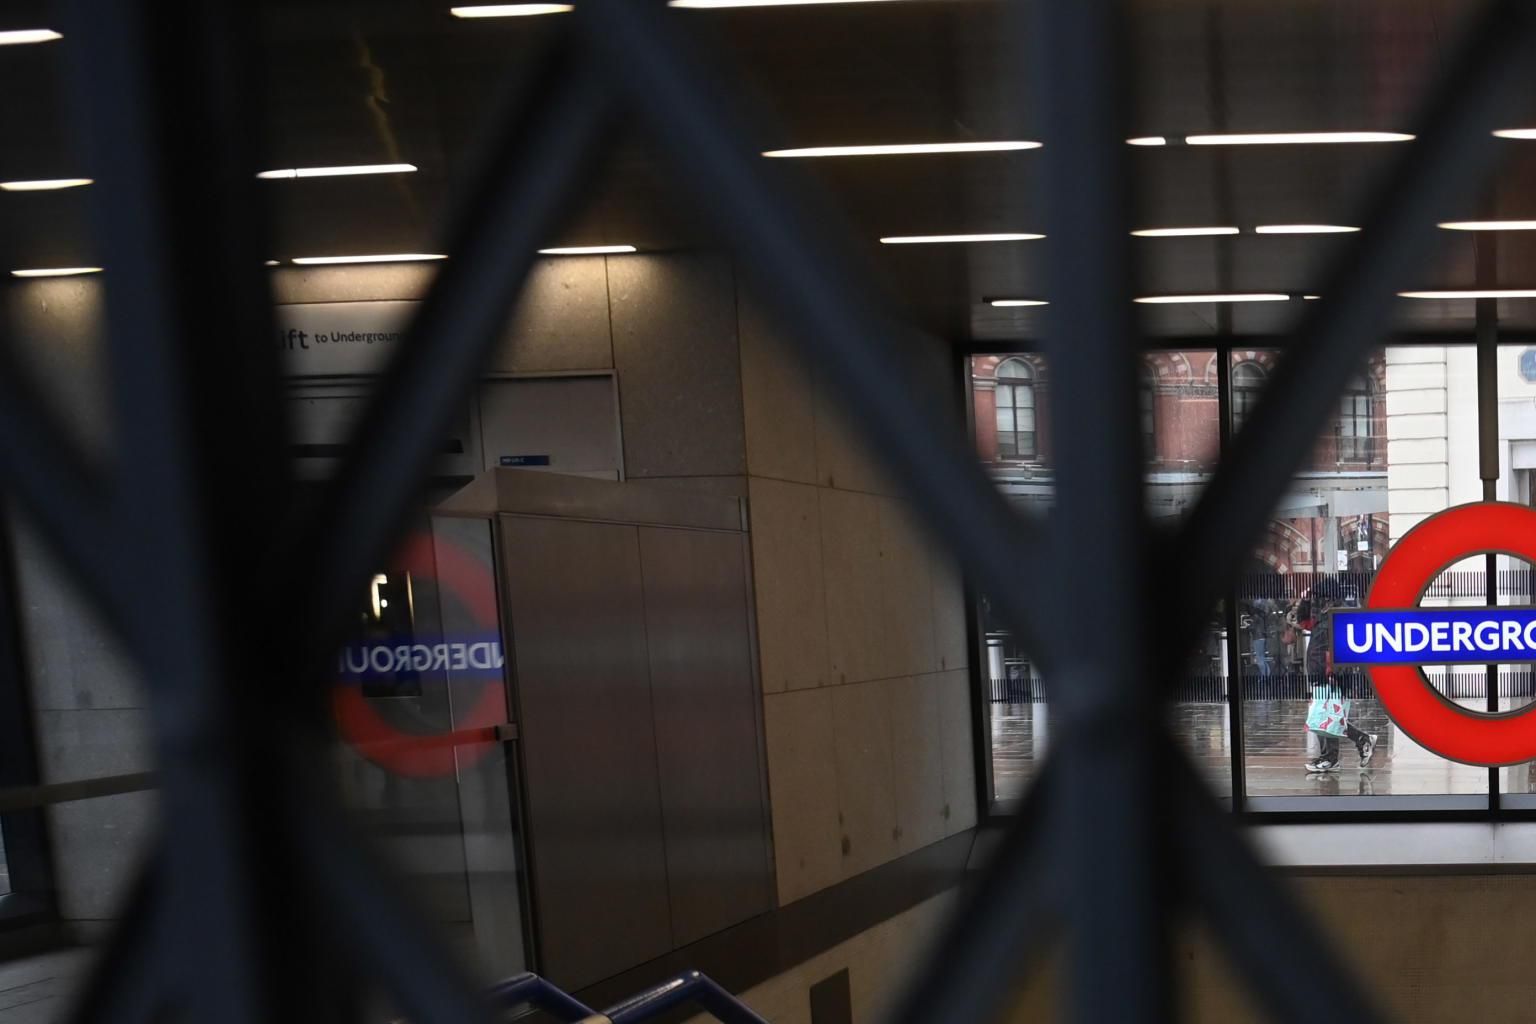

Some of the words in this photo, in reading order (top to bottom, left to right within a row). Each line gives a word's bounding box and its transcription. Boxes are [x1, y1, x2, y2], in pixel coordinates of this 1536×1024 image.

[277, 329, 309, 350] ift
[314, 333, 328, 344] to
[331, 331, 402, 344] Undergroun
